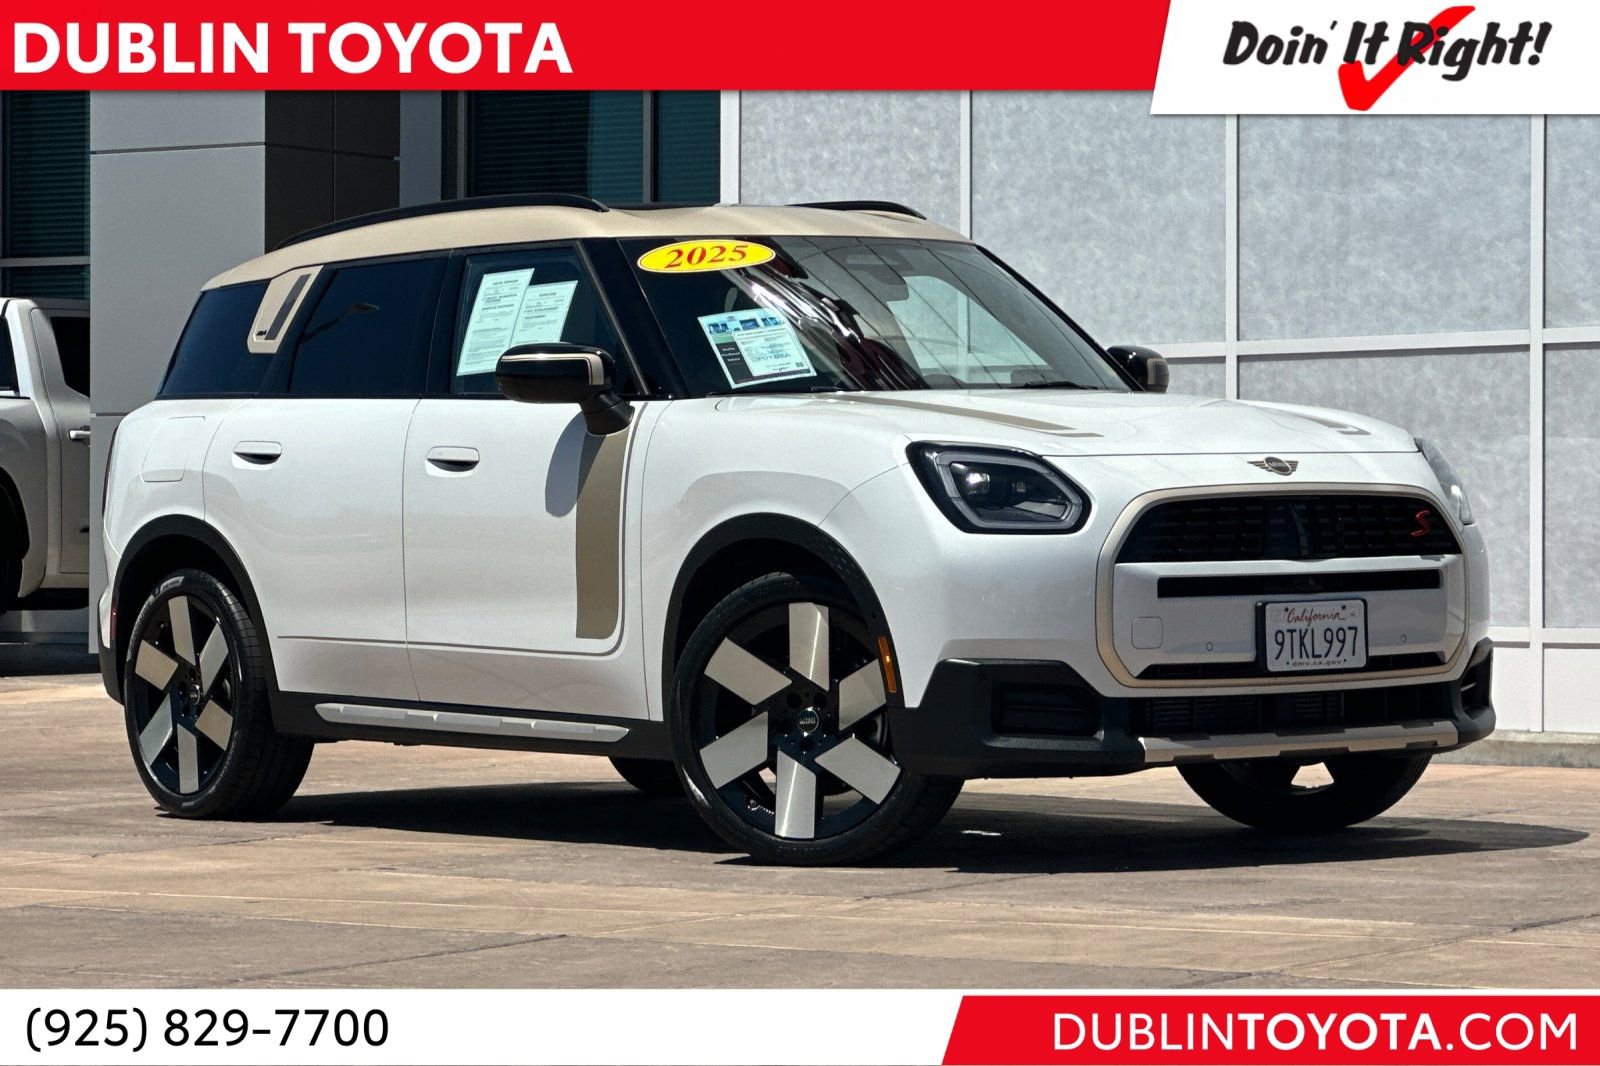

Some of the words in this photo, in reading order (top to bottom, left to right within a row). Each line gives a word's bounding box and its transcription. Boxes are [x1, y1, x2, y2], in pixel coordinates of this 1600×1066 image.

[664, 244, 749, 269] 2025
[1411, 510, 1430, 537] S
[1286, 608, 1346, 627] California
[1274, 626, 1359, 661] 9TKL997
[1292, 658, 1342, 667] dmv.ca.gov
